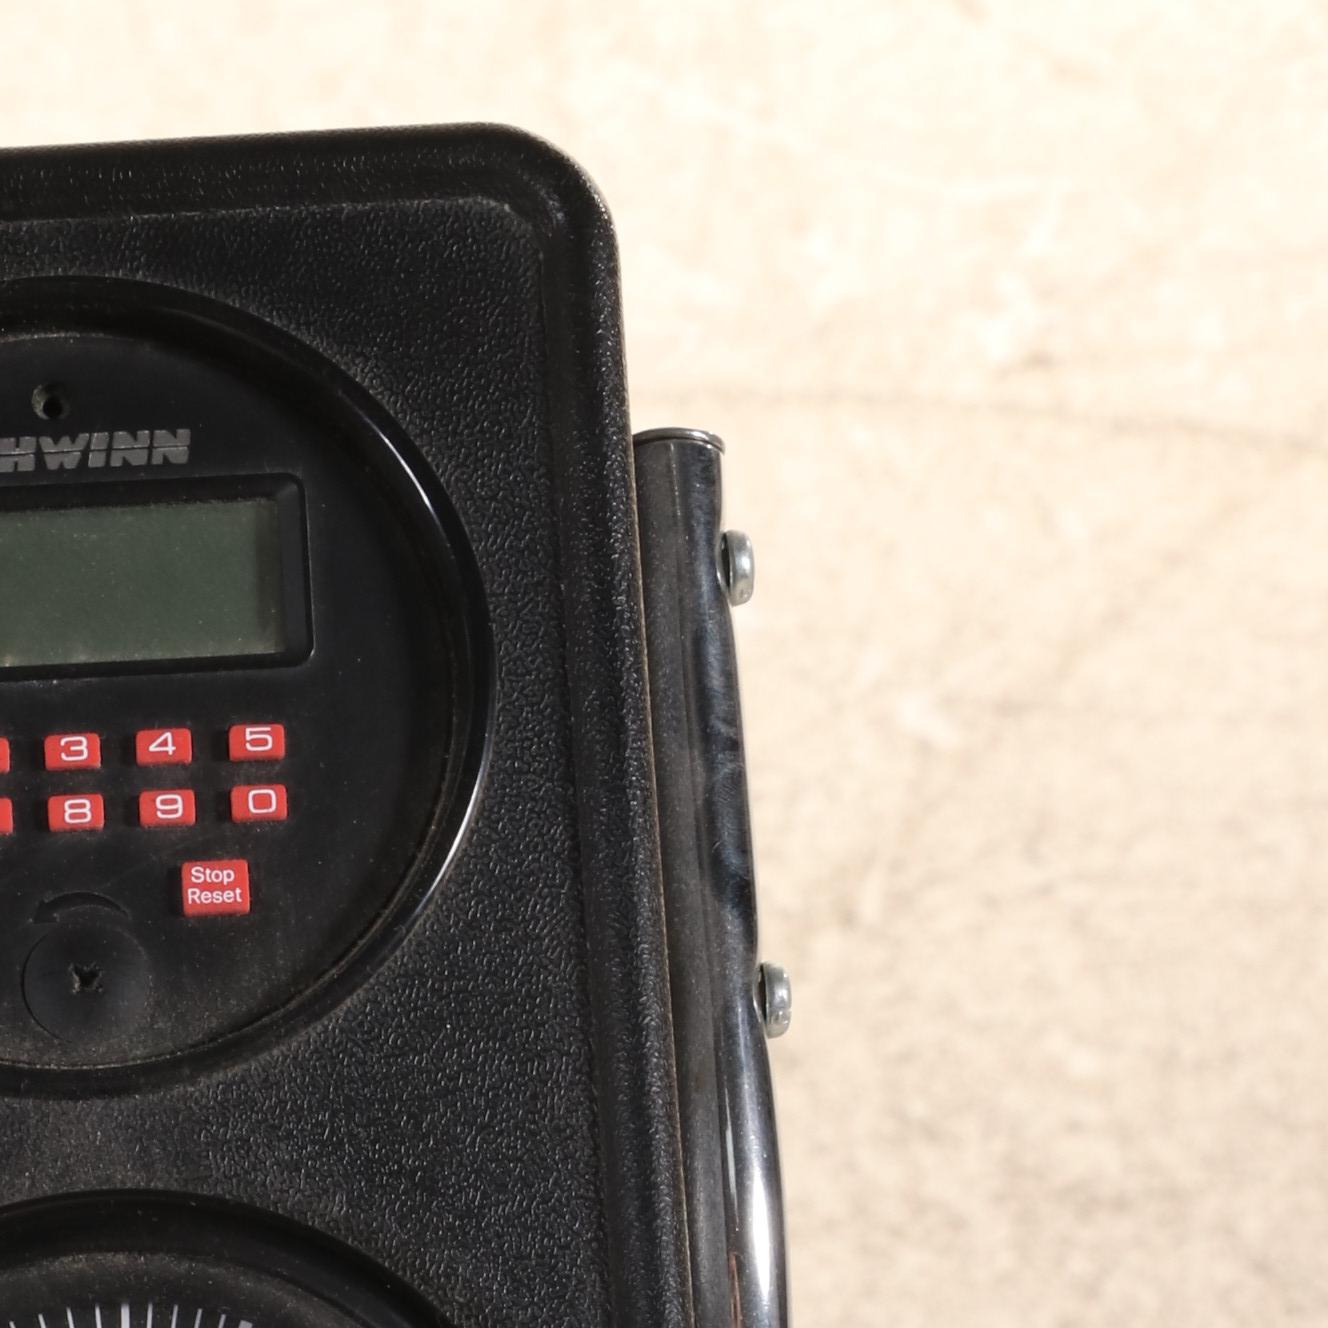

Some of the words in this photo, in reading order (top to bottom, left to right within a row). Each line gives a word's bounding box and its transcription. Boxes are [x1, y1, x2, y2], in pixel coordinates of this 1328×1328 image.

[59, 736, 89, 761] 3
[148, 731, 176, 756] 4
[244, 727, 273, 752] 5
[63, 799, 92, 824] 8
[155, 794, 184, 819] 9
[247, 788, 277, 813] 0
[190, 866, 235, 887] Stop
[187, 885, 242, 906] Reset
